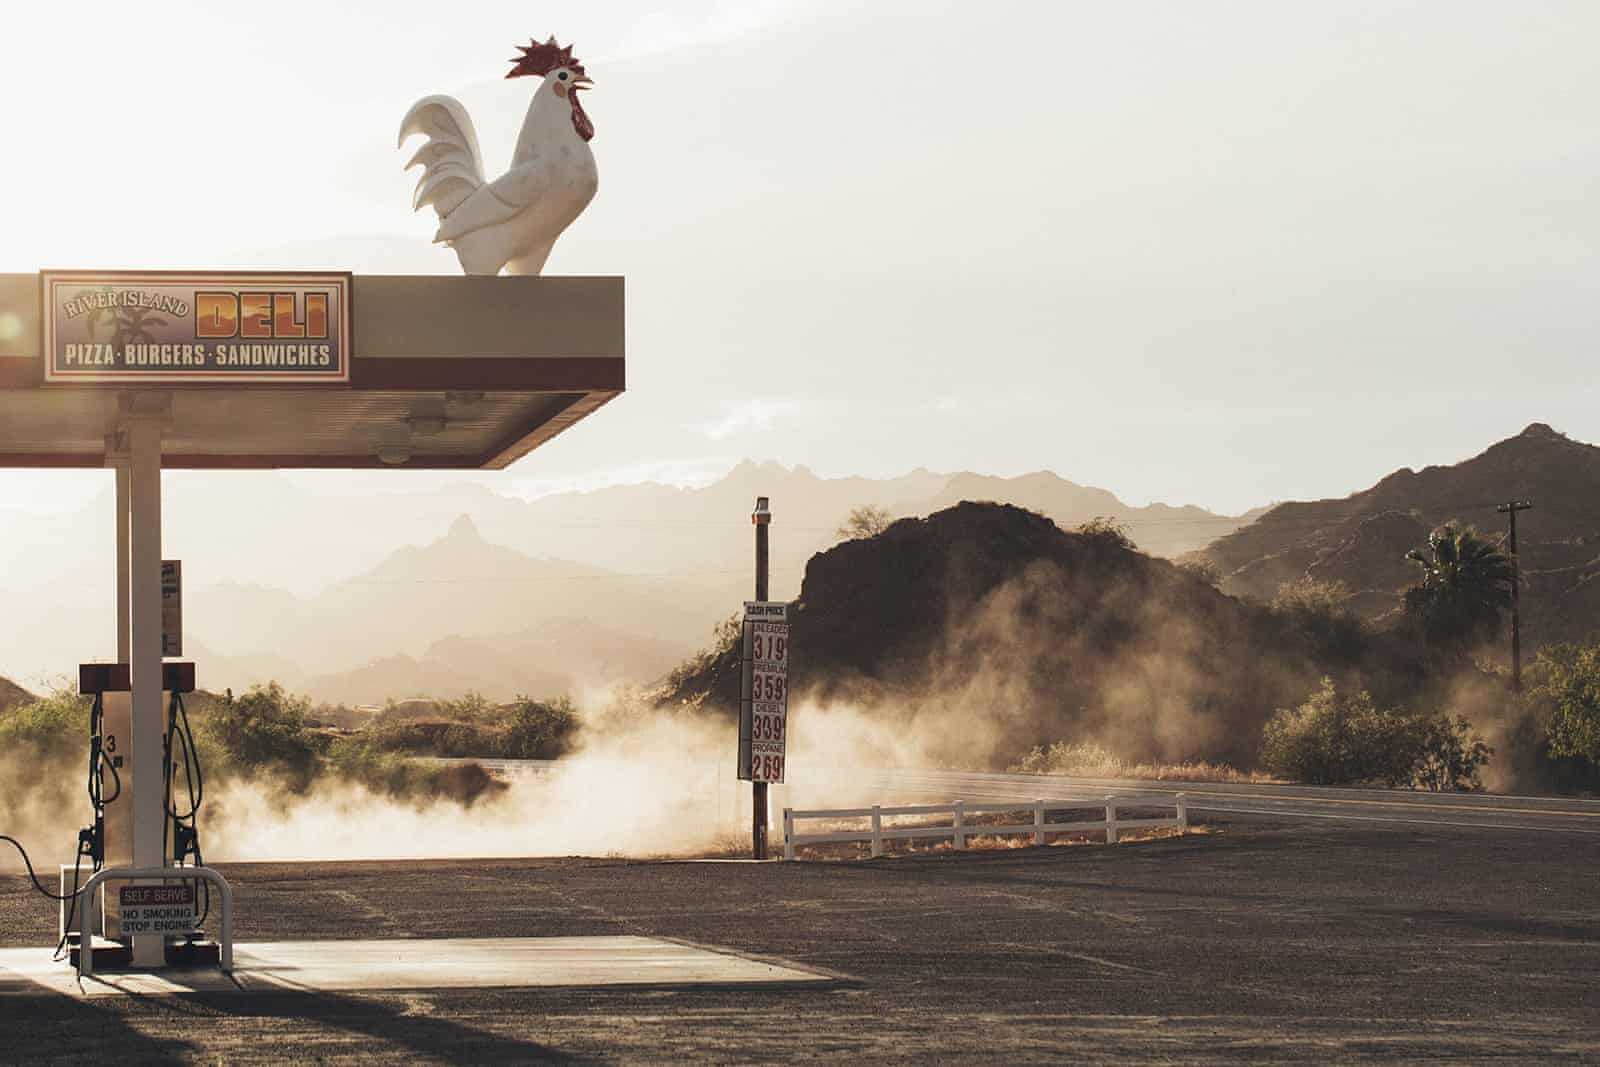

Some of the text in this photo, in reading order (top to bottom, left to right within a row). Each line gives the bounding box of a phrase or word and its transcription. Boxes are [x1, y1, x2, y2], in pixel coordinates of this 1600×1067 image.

[64, 290, 189, 319] RIVER ISLAND
[194, 291, 329, 339] DELI
[65, 343, 330, 366] PIZZA BURGERS SANDWICHES
[754, 634, 785, 661] 319
[754, 674, 783, 700] 359
[106, 735, 116, 753] 3
[752, 743, 783, 753] PROPANE
[752, 755, 781, 780] 269
[124, 888, 188, 902] SELF SERVE
[122, 908, 192, 920] NO SMOKING
[122, 920, 192, 932] STOP ENGINE
